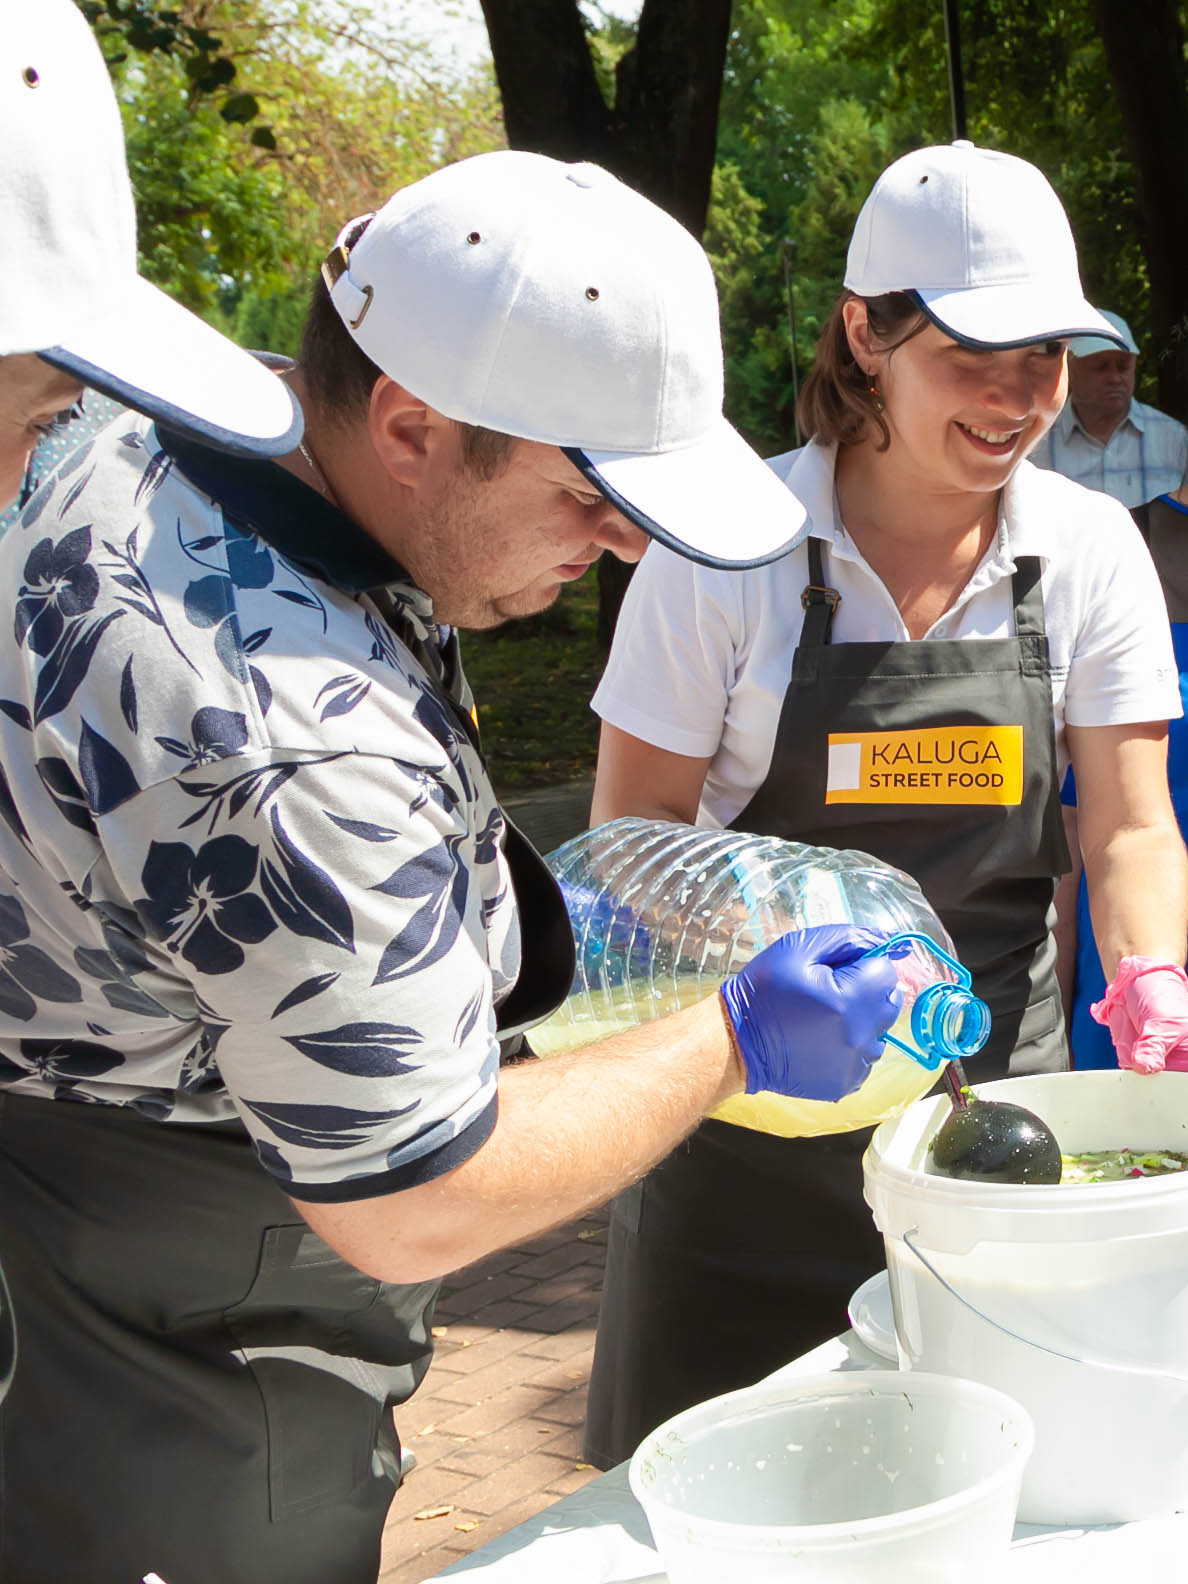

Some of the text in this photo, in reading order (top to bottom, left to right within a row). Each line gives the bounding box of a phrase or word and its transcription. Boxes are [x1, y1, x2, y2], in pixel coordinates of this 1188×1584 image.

[872, 740, 1002, 766] KALUGA
[869, 773, 1004, 788] STREET FOOD
